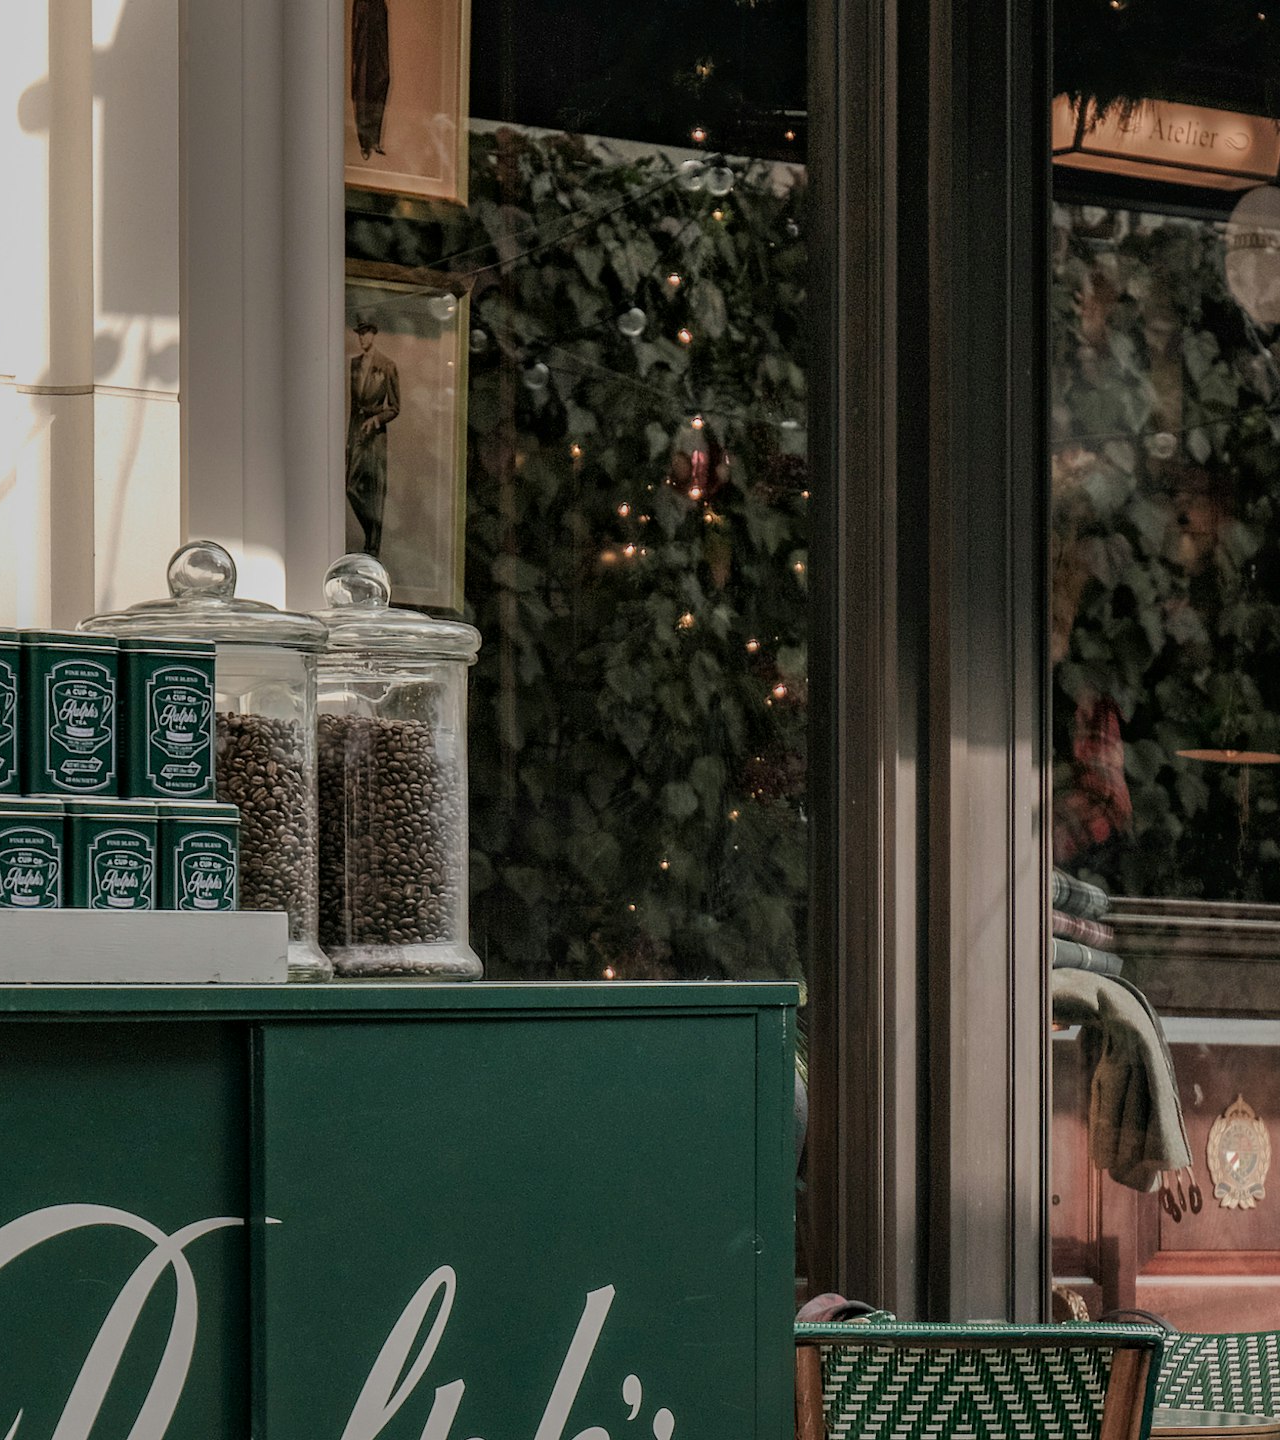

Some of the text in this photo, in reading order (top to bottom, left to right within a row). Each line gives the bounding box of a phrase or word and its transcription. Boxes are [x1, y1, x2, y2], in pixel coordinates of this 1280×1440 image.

[1148, 118, 1219, 149] Atelier
[59, 699, 98, 726] Ralph's
[160, 704, 197, 731] Ralph's
[4, 867, 44, 895] Ralph's
[101, 869, 138, 897] Ralph's
[188, 871, 222, 898] Ralph's
